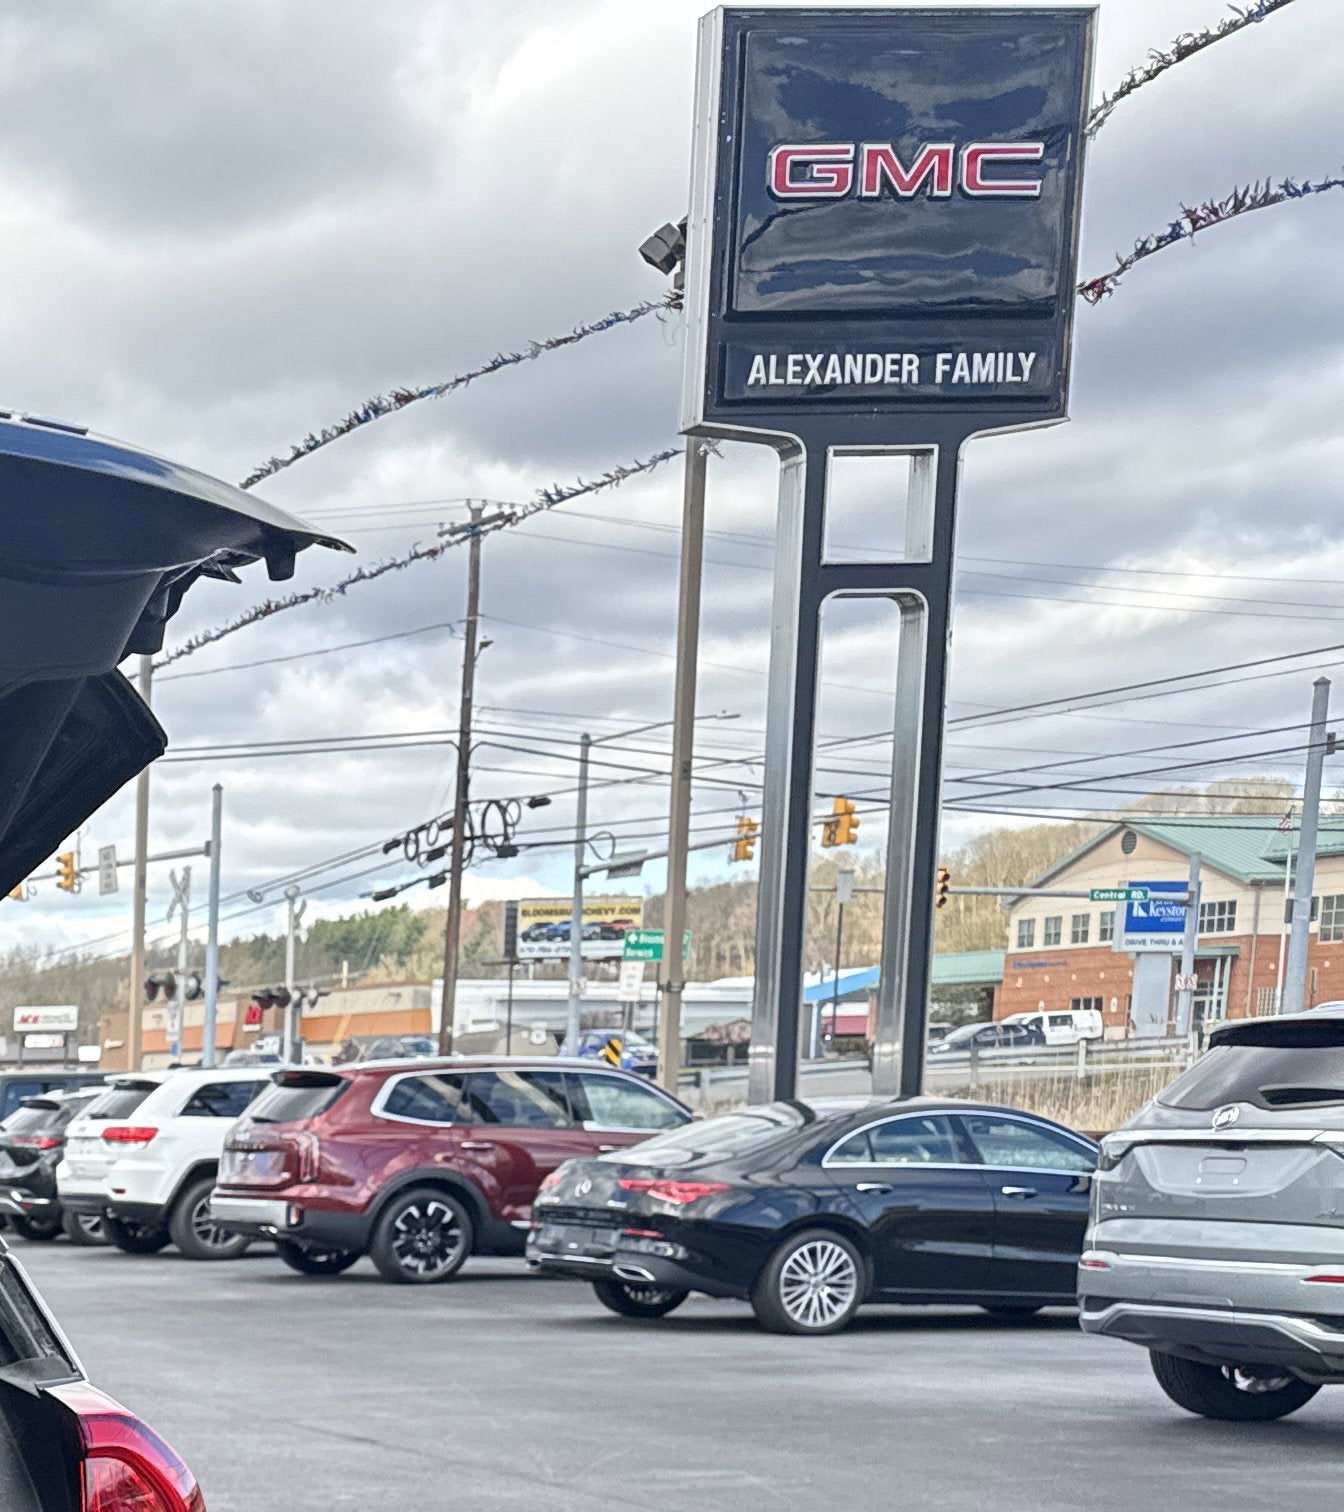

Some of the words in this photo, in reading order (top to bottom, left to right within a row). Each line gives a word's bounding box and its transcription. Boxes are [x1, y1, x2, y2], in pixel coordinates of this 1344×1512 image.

[768, 142, 1045, 199] GMC
[747, 353, 919, 386] ALEXANDER
[934, 352, 1037, 384] FAMILY
